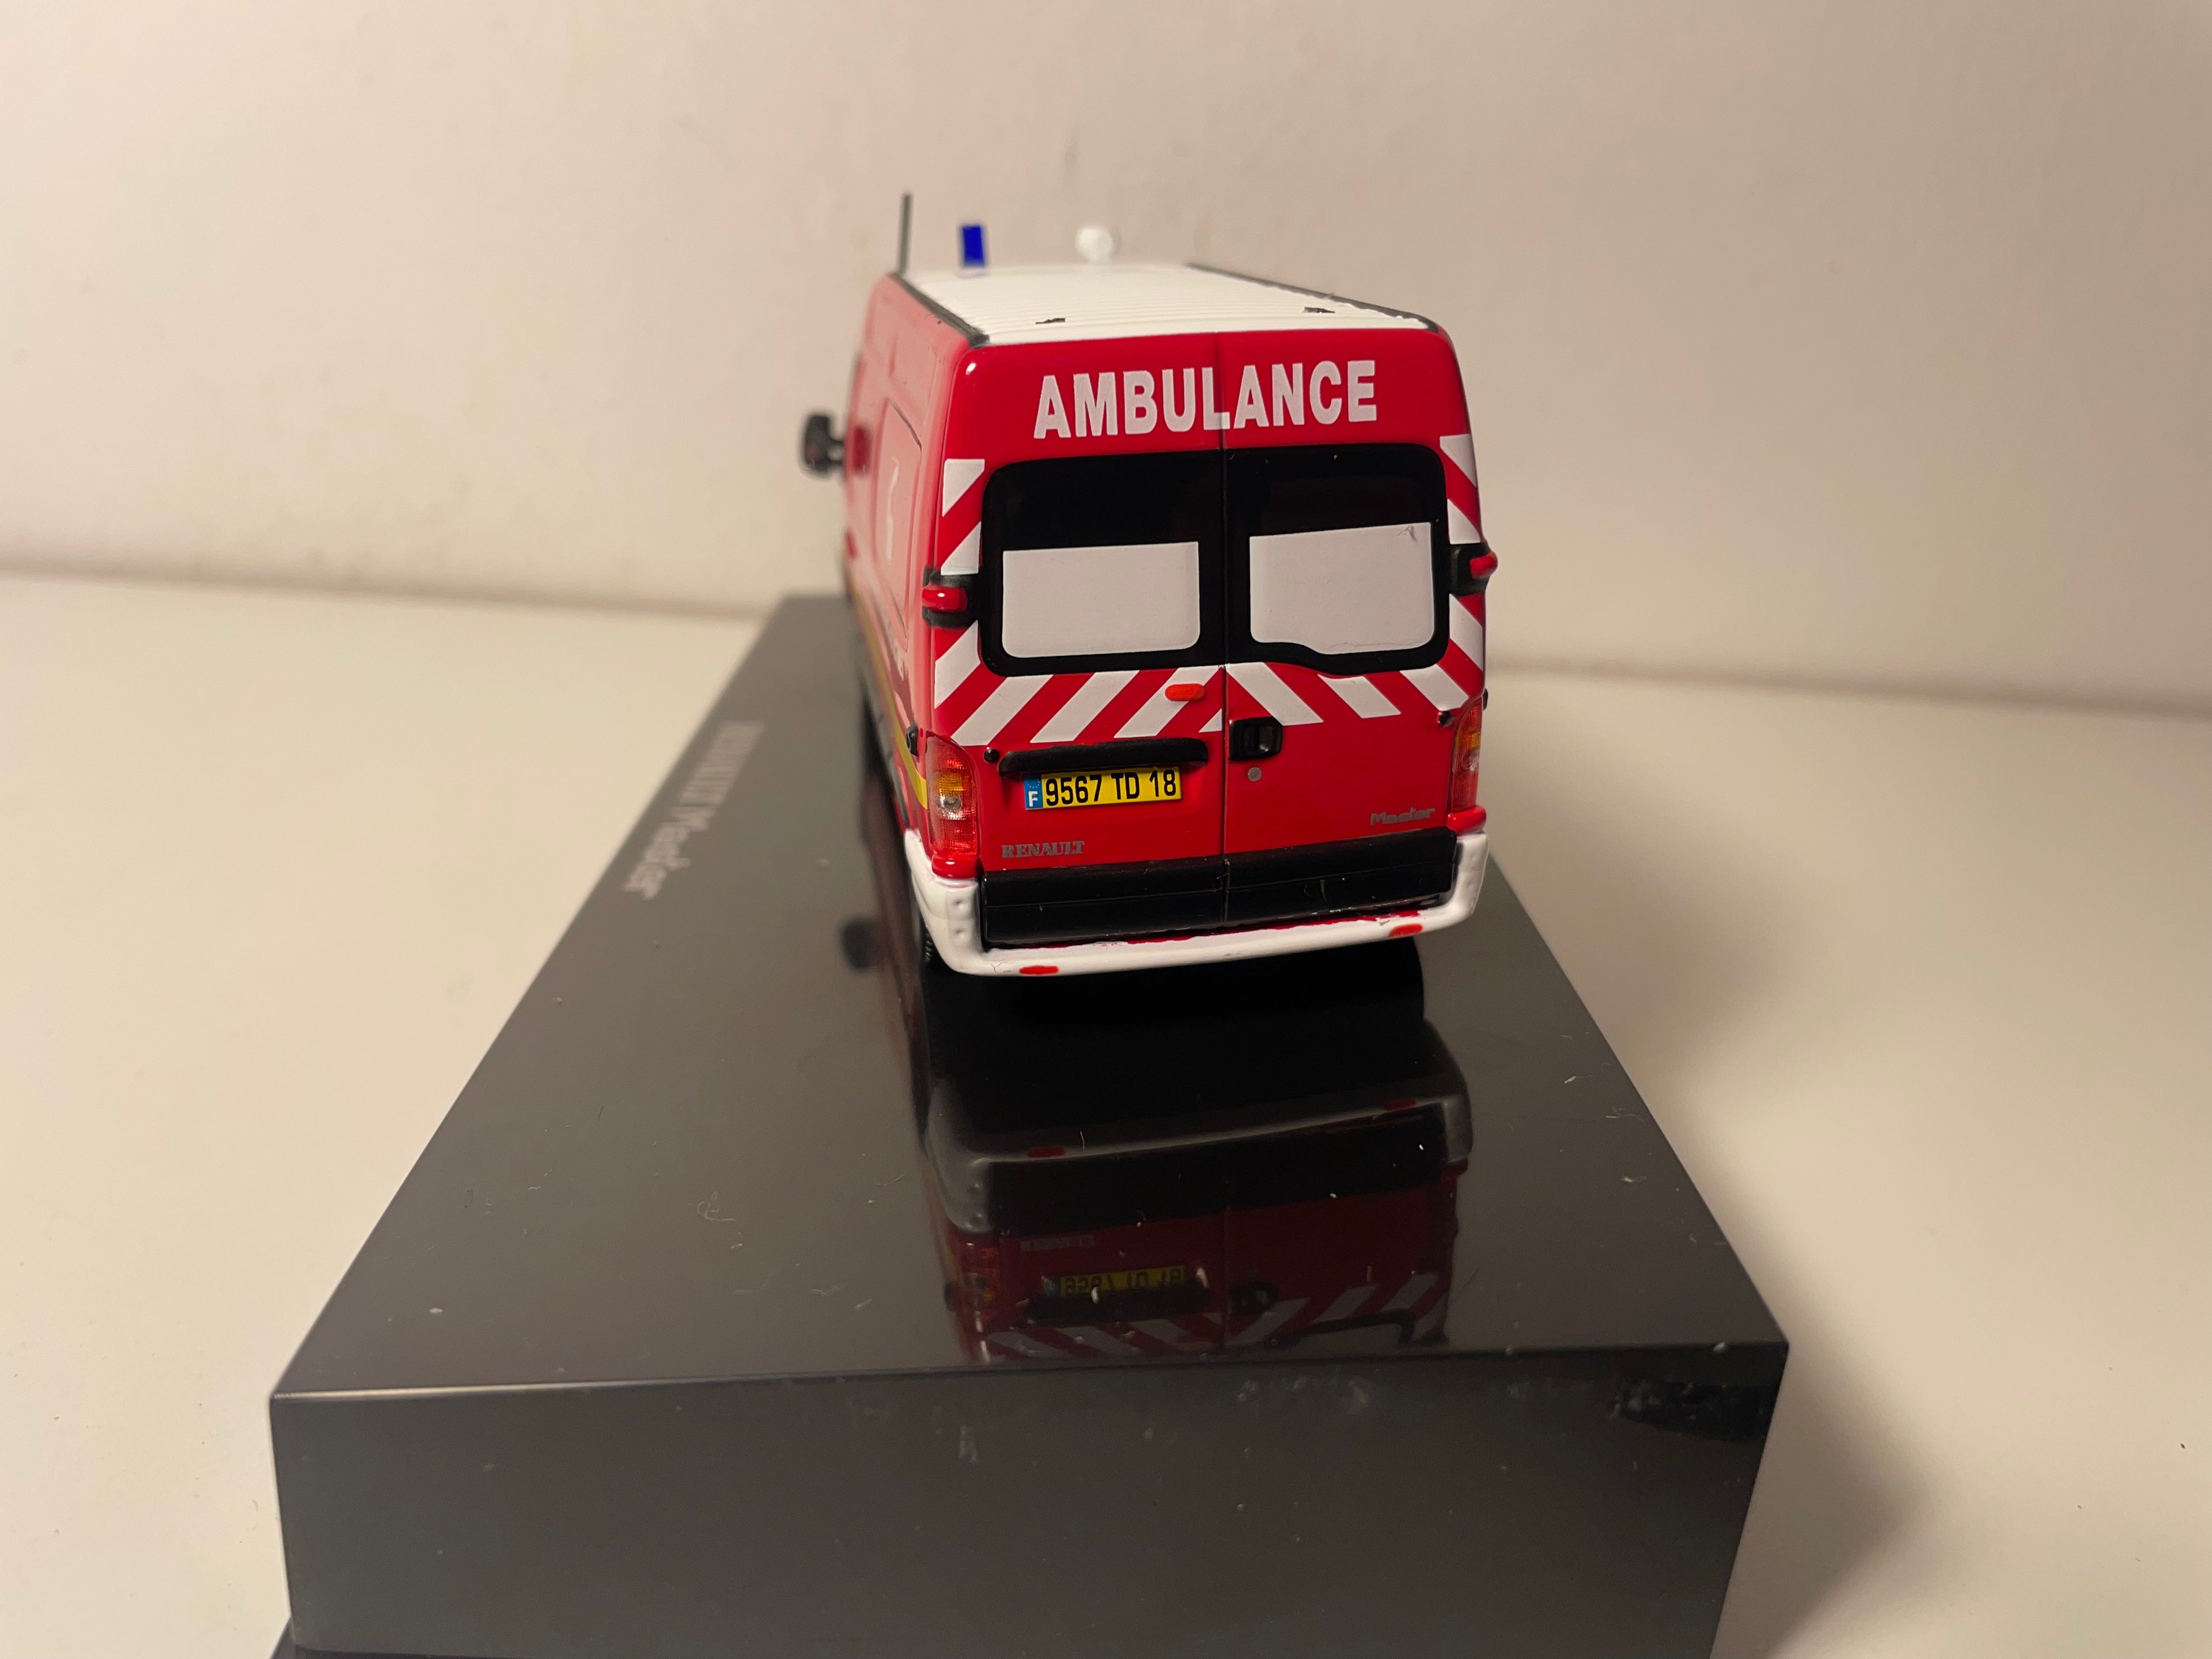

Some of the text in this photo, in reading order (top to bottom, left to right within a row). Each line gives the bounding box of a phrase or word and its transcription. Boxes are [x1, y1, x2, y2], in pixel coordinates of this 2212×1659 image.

[1033, 360, 1377, 439] AMBULANCE
[1028, 768, 1177, 807] F 9567 TD 18
[1001, 840, 1085, 859] RENAULT
